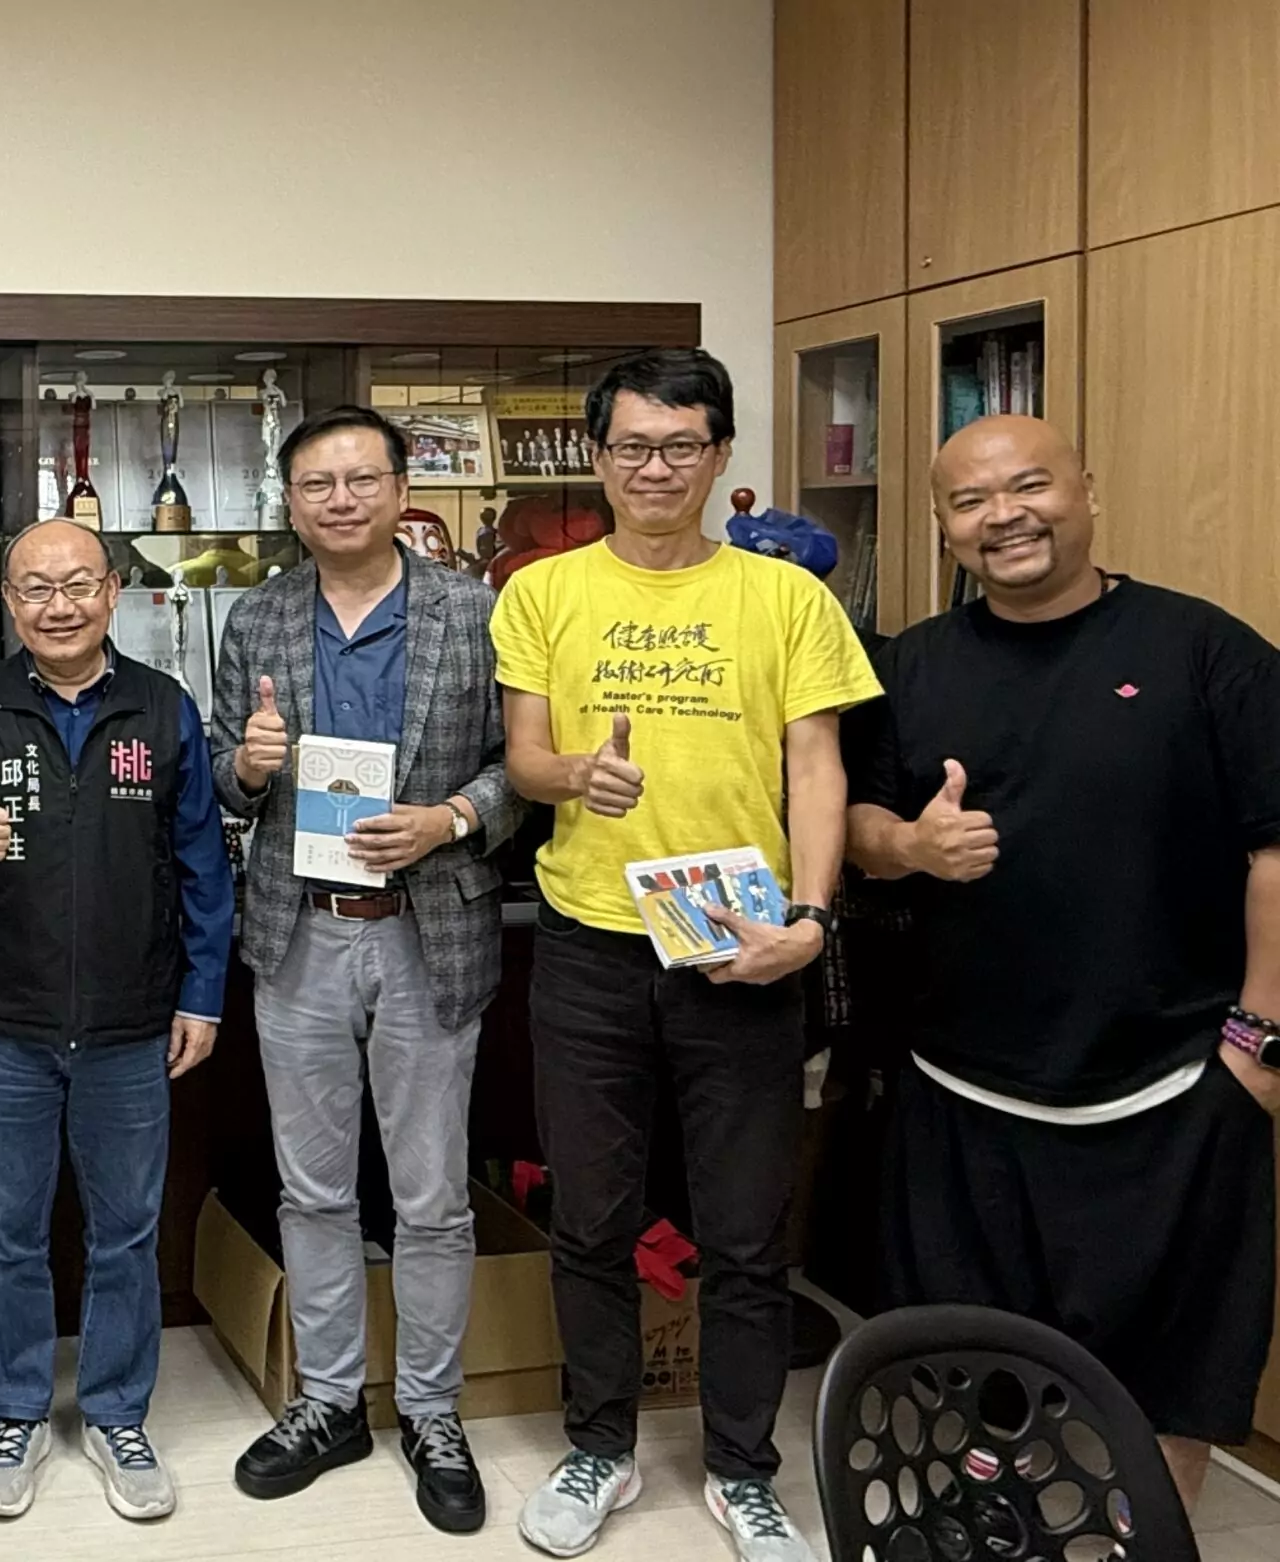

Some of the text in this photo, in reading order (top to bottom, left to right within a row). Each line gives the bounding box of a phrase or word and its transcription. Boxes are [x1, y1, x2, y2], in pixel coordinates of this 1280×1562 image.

[603, 691, 709, 705] Master's program
[592, 704, 630, 714] Health
[636, 704, 664, 716] Care
[670, 706, 743, 722] Technology
[25, 743, 41, 812] 文化局長
